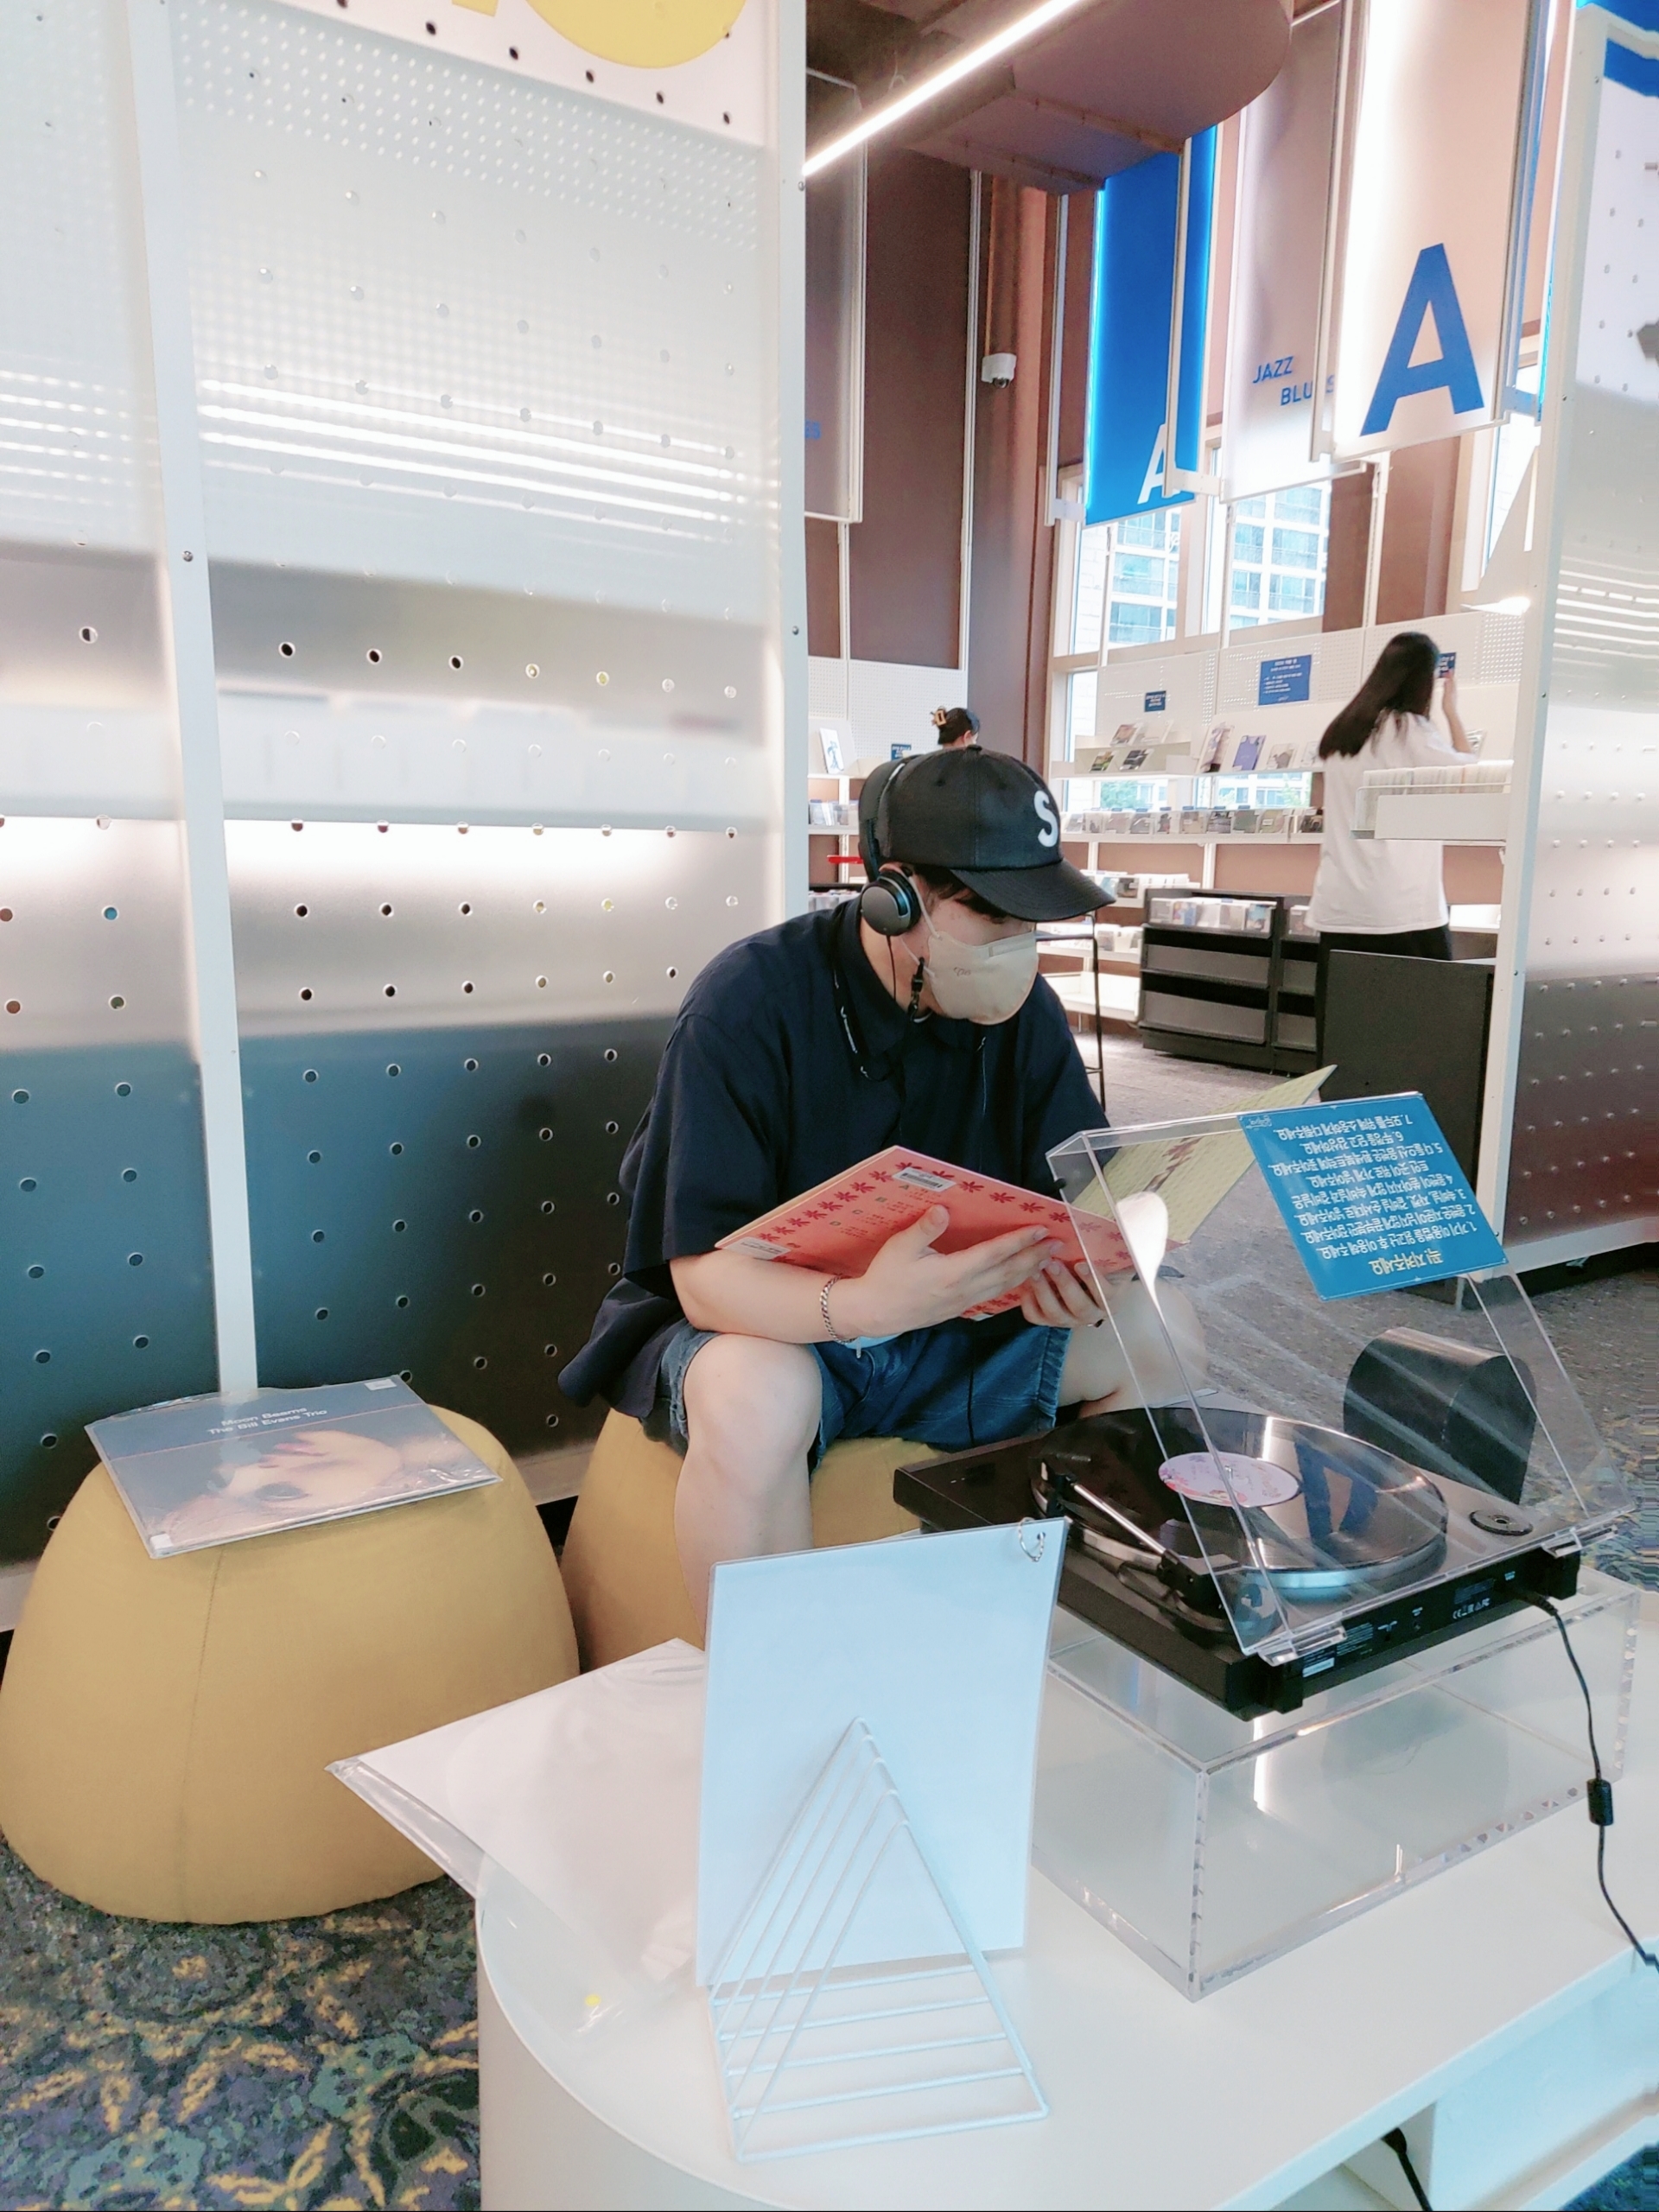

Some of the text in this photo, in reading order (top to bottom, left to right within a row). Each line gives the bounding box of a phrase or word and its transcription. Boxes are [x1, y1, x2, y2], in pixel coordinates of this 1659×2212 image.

[1360, 243, 1484, 436] A
[1253, 356, 1294, 384] JAZZ
[1281, 374, 1335, 406] BLUS
[1137, 423, 1182, 505] A
[1034, 791, 1058, 847] S
[1376, 1236, 1389, 1249] 후
[1368, 1251, 1426, 1275] 지켜주세요
[208, 1409, 328, 1435] The Bill Evans Trio
[221, 1407, 308, 1427] Moon Beams
